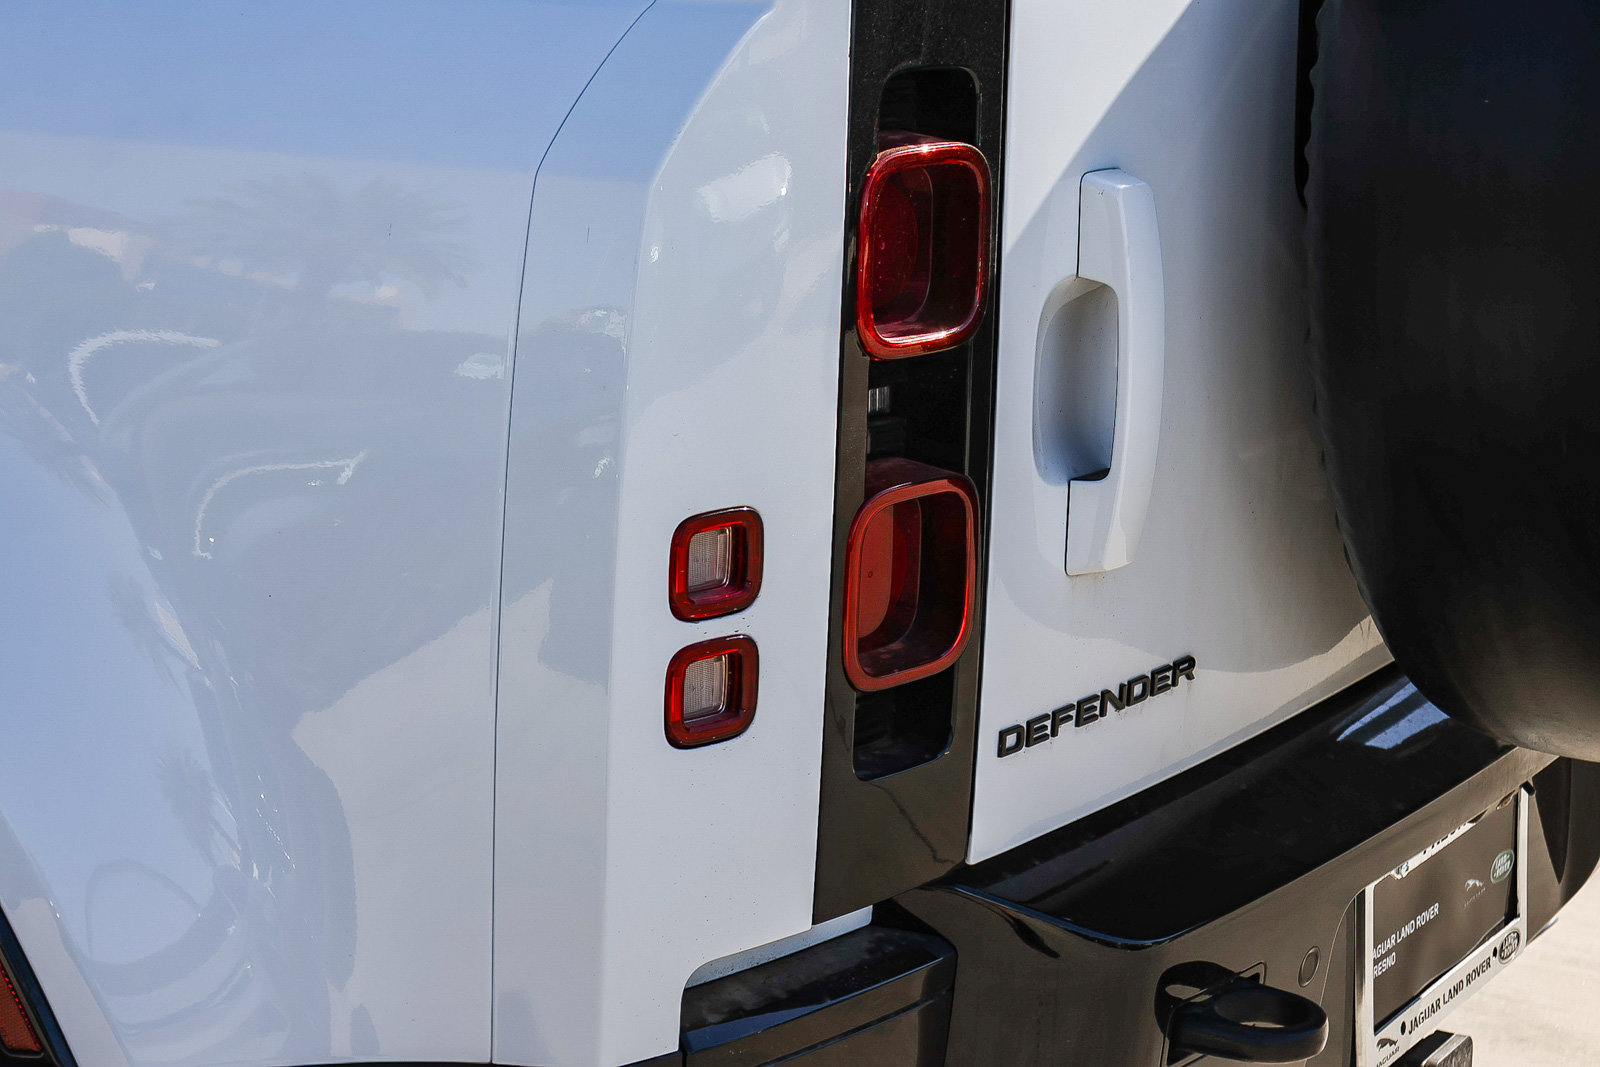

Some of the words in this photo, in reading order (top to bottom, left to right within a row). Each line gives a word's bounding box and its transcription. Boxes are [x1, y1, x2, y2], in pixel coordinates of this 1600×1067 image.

[997, 655, 1196, 758] DEFENDER
[1373, 934, 1396, 960] AGUAR
[1396, 920, 1415, 944] LAND
[1416, 902, 1439, 930] ROVER
[1373, 951, 1396, 979] RESNO
[1408, 998, 1441, 1035] JAGUAR
[1443, 980, 1464, 1005] LAND
[1466, 956, 1491, 988] ROVER
